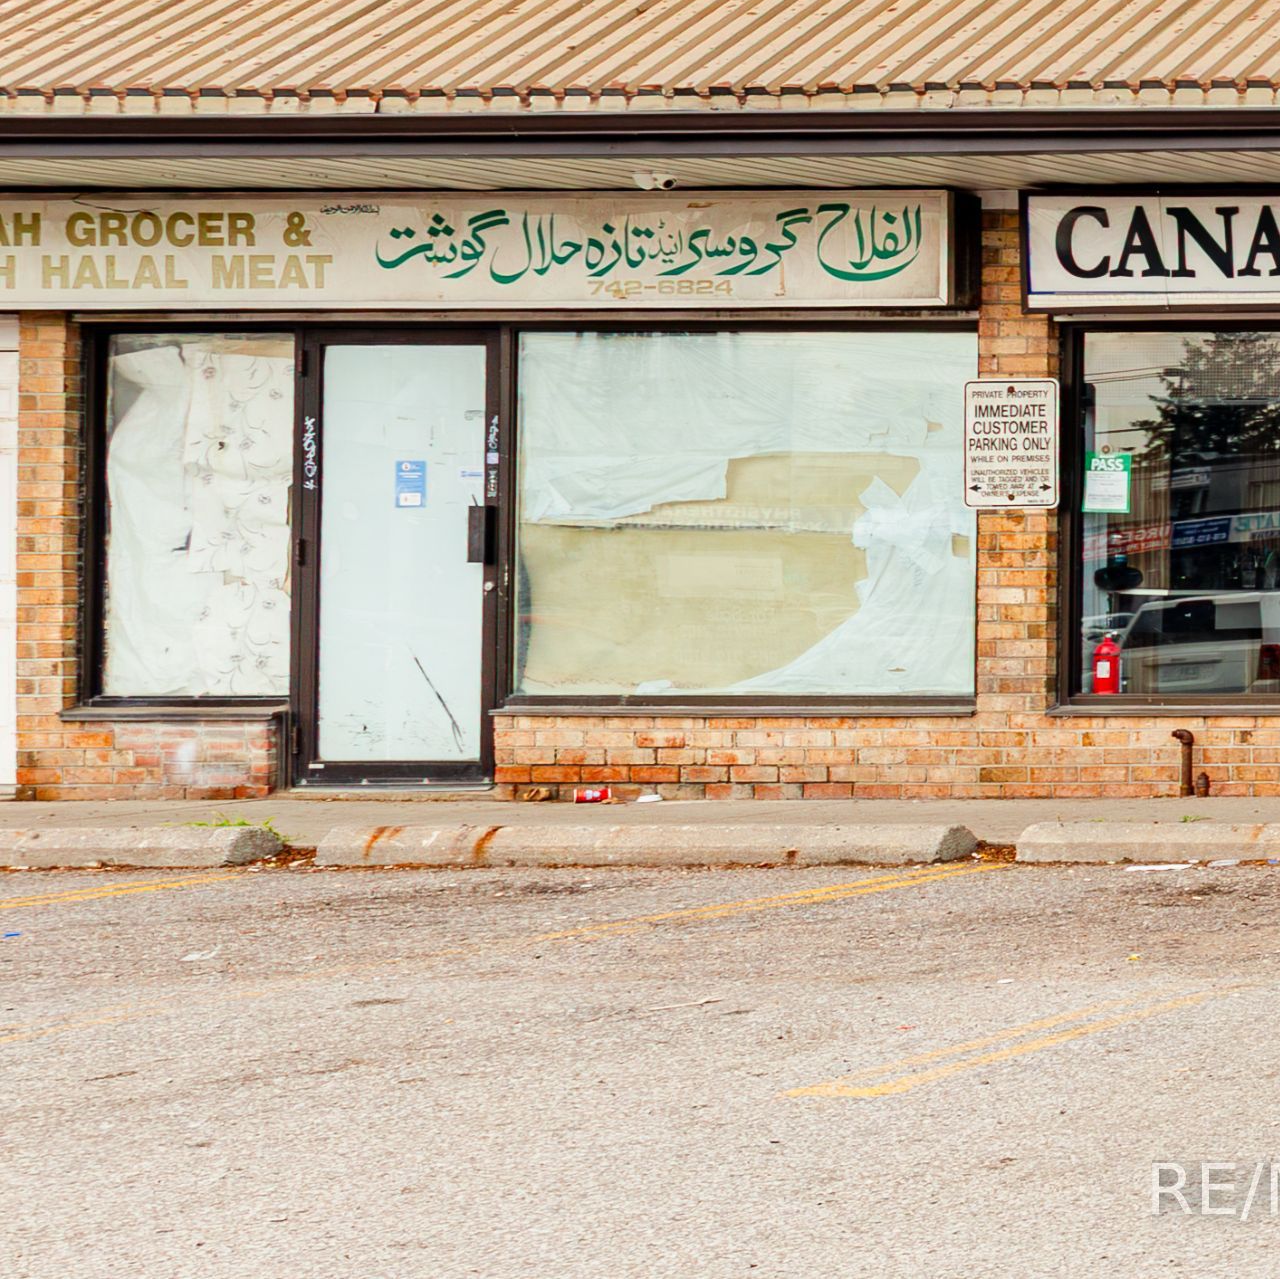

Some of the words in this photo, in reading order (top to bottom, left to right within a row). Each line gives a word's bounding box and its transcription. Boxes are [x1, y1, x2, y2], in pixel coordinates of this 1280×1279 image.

[65, 211, 256, 248] GROCER
[283, 211, 313, 247] &
[375, 209, 511, 279] گوشت
[489, 209, 583, 285] حلال
[41, 255, 188, 289] HALAL
[211, 255, 333, 289] MEAT
[588, 280, 733, 297] 742-6824
[972, 390, 1003, 399] PRIVATE
[1007, 390, 1049, 399] PROPERTY
[974, 404, 1046, 418] IMMEDIATE
[972, 420, 1048, 435] CUSTOMER
[968, 437, 1017, 451] PARKING
[1022, 437, 1051, 451] ONLY
[970, 455, 995, 463] WHILE
[997, 455, 1009, 463] ON
[1011, 454, 1050, 463] PREMISES
[1091, 458, 1124, 470] PASS
